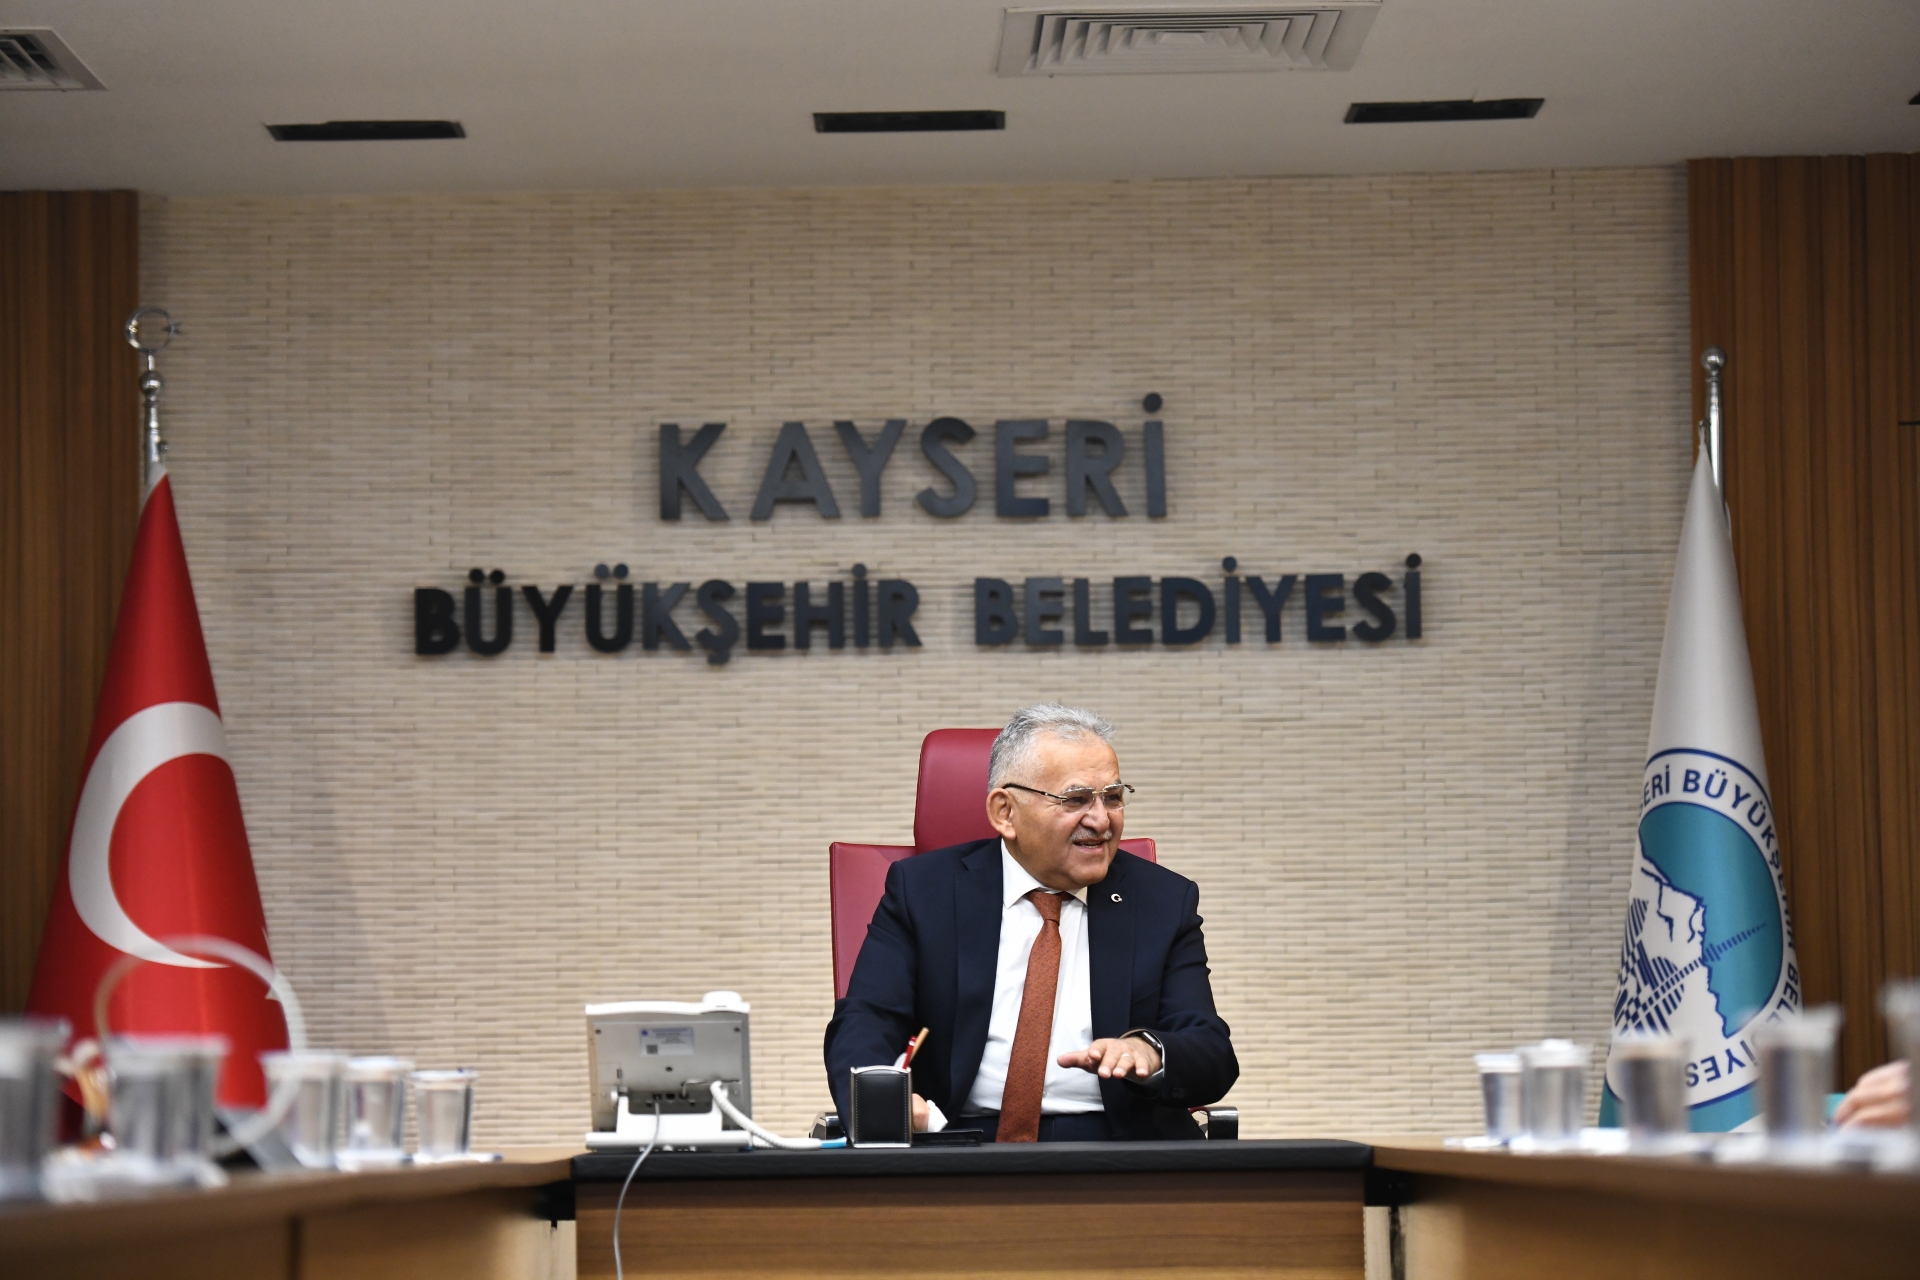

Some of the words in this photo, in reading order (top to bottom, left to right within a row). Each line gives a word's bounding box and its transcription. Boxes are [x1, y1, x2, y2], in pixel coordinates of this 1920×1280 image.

[658, 393, 1168, 522] KAYSERİ
[414, 563, 923, 666] BÜYÜKŞEHİR
[975, 553, 1423, 647] BELEDİYESİ
